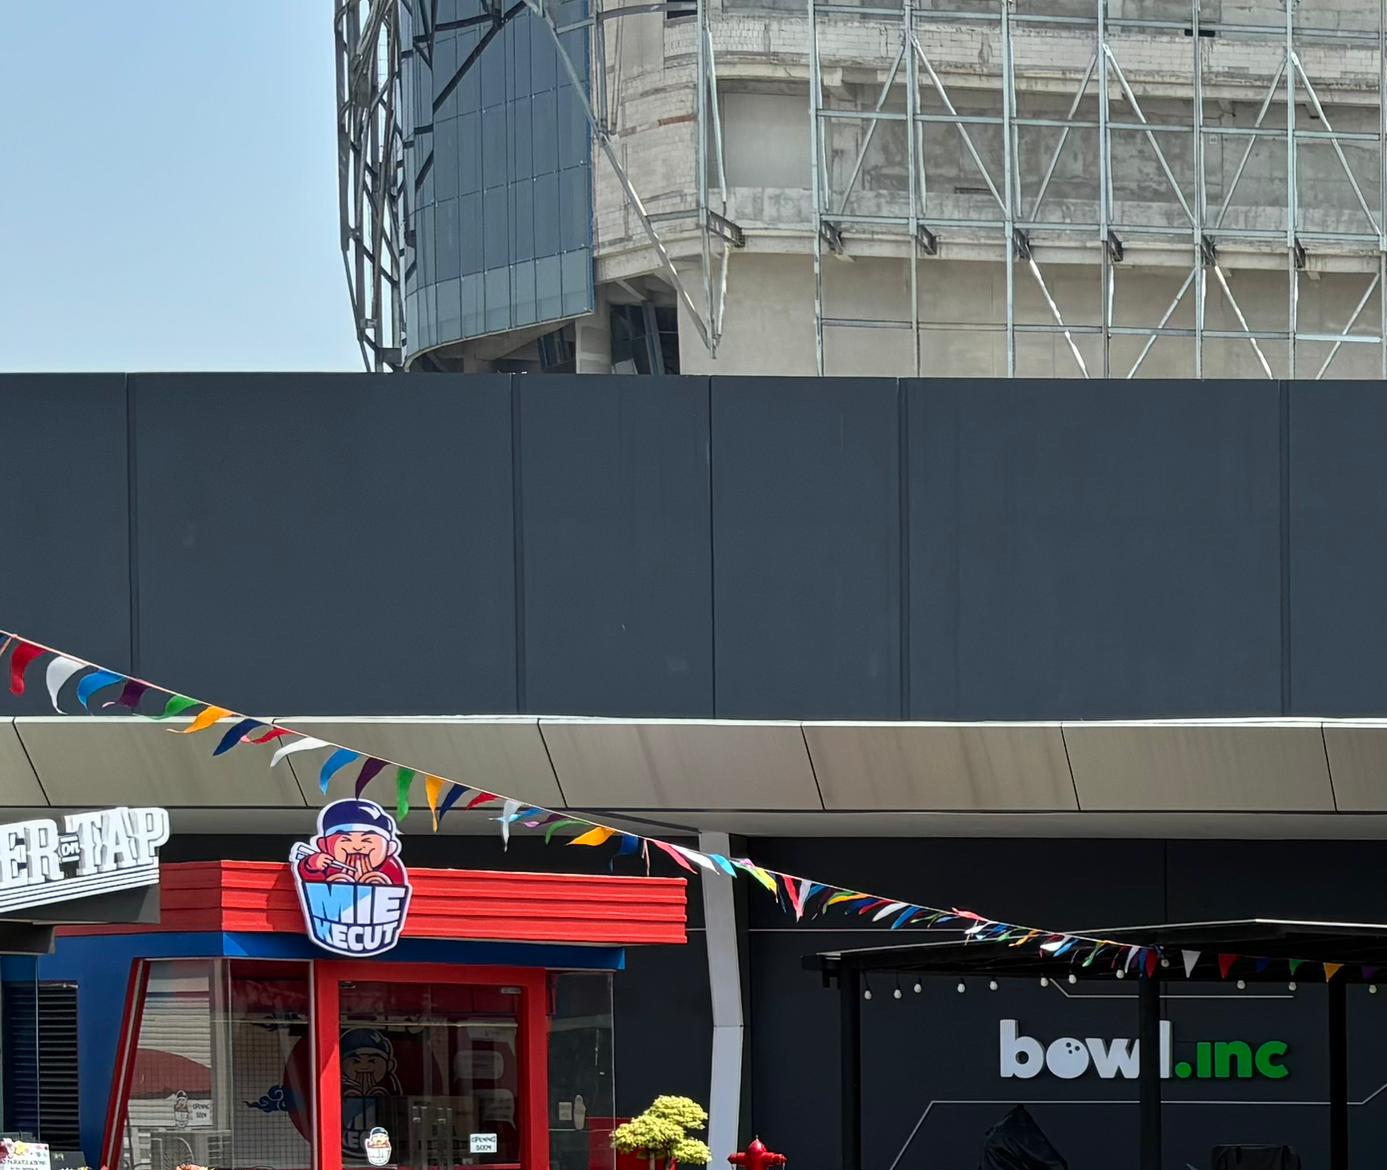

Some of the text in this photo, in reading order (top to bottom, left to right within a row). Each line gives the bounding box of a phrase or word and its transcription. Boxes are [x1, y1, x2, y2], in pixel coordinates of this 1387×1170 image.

[64, 807, 170, 877] TAP
[304, 882, 406, 924] MIE
[313, 917, 399, 951] KECUT
